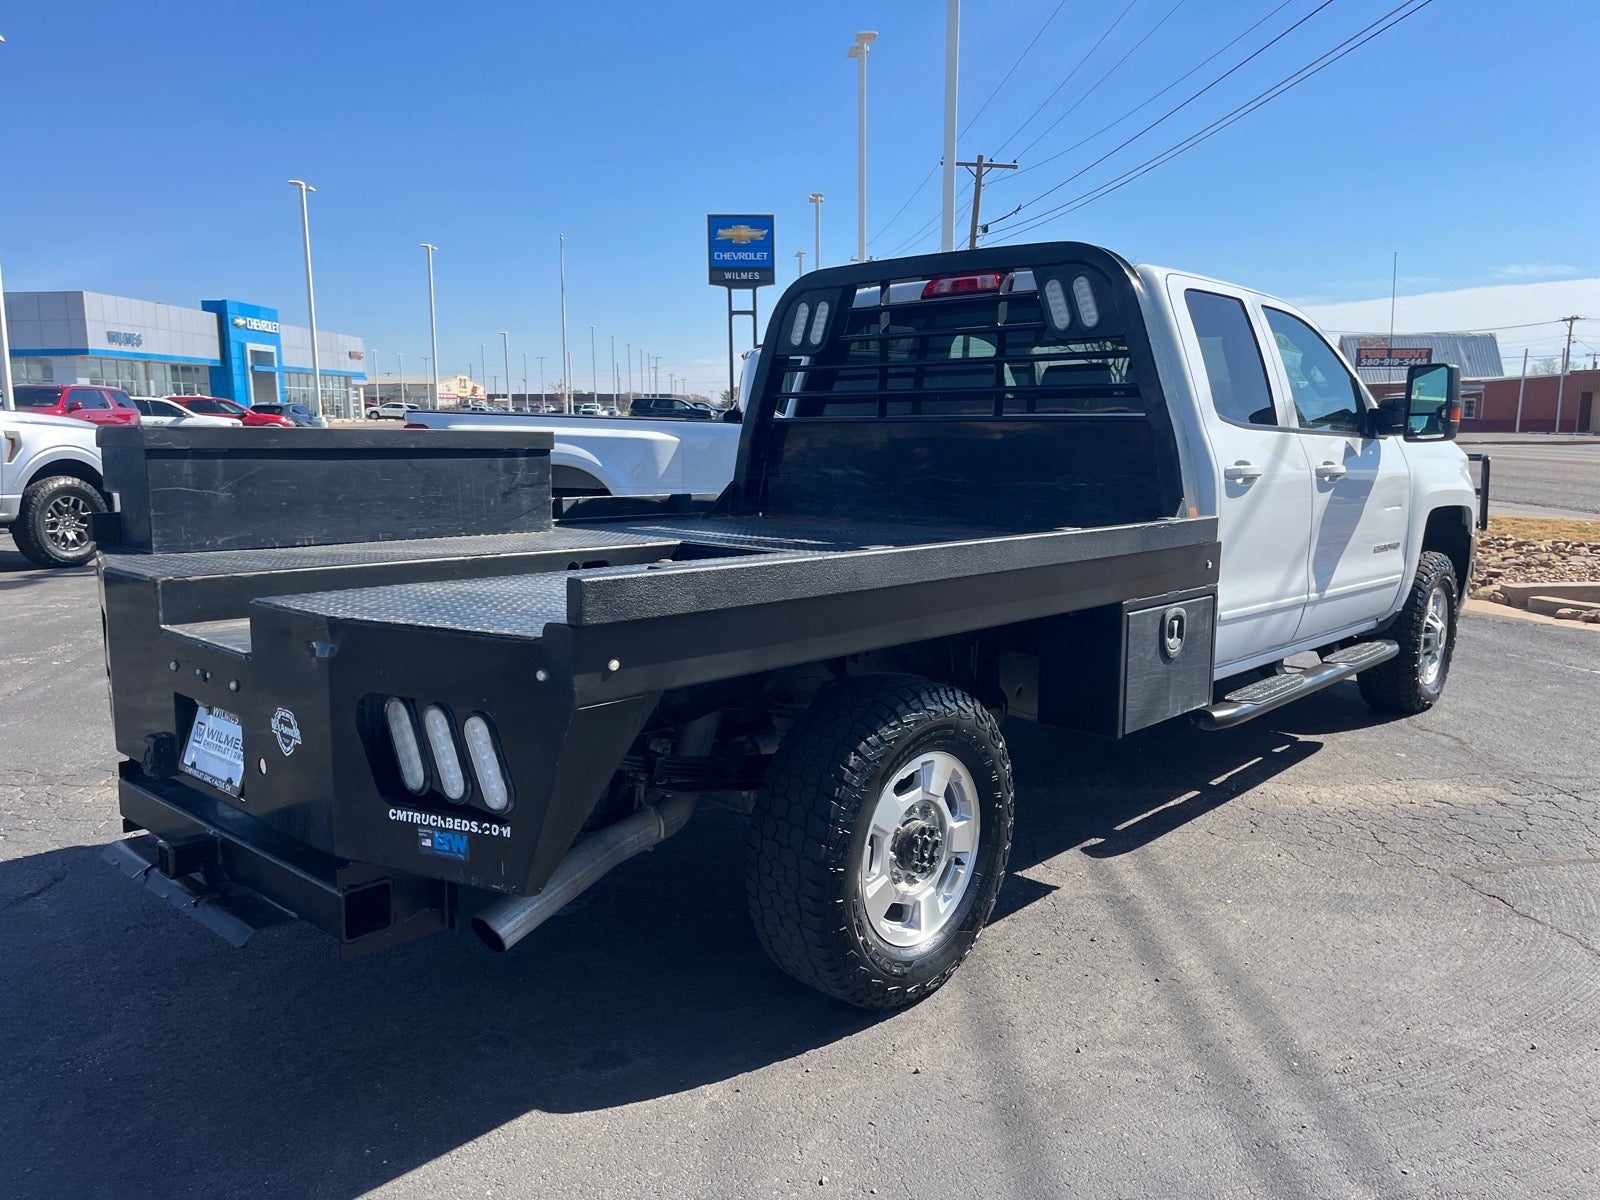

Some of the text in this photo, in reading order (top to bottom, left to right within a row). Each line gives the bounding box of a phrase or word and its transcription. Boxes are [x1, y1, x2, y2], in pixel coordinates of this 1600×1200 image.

[714, 252, 768, 260] CHEVROLET
[724, 272, 760, 280] WILMES
[246, 317, 280, 333] CHEVROLET
[1360, 349, 1429, 358] FOR RENT
[388, 808, 511, 838] CMTRUCKBEDS.COM
